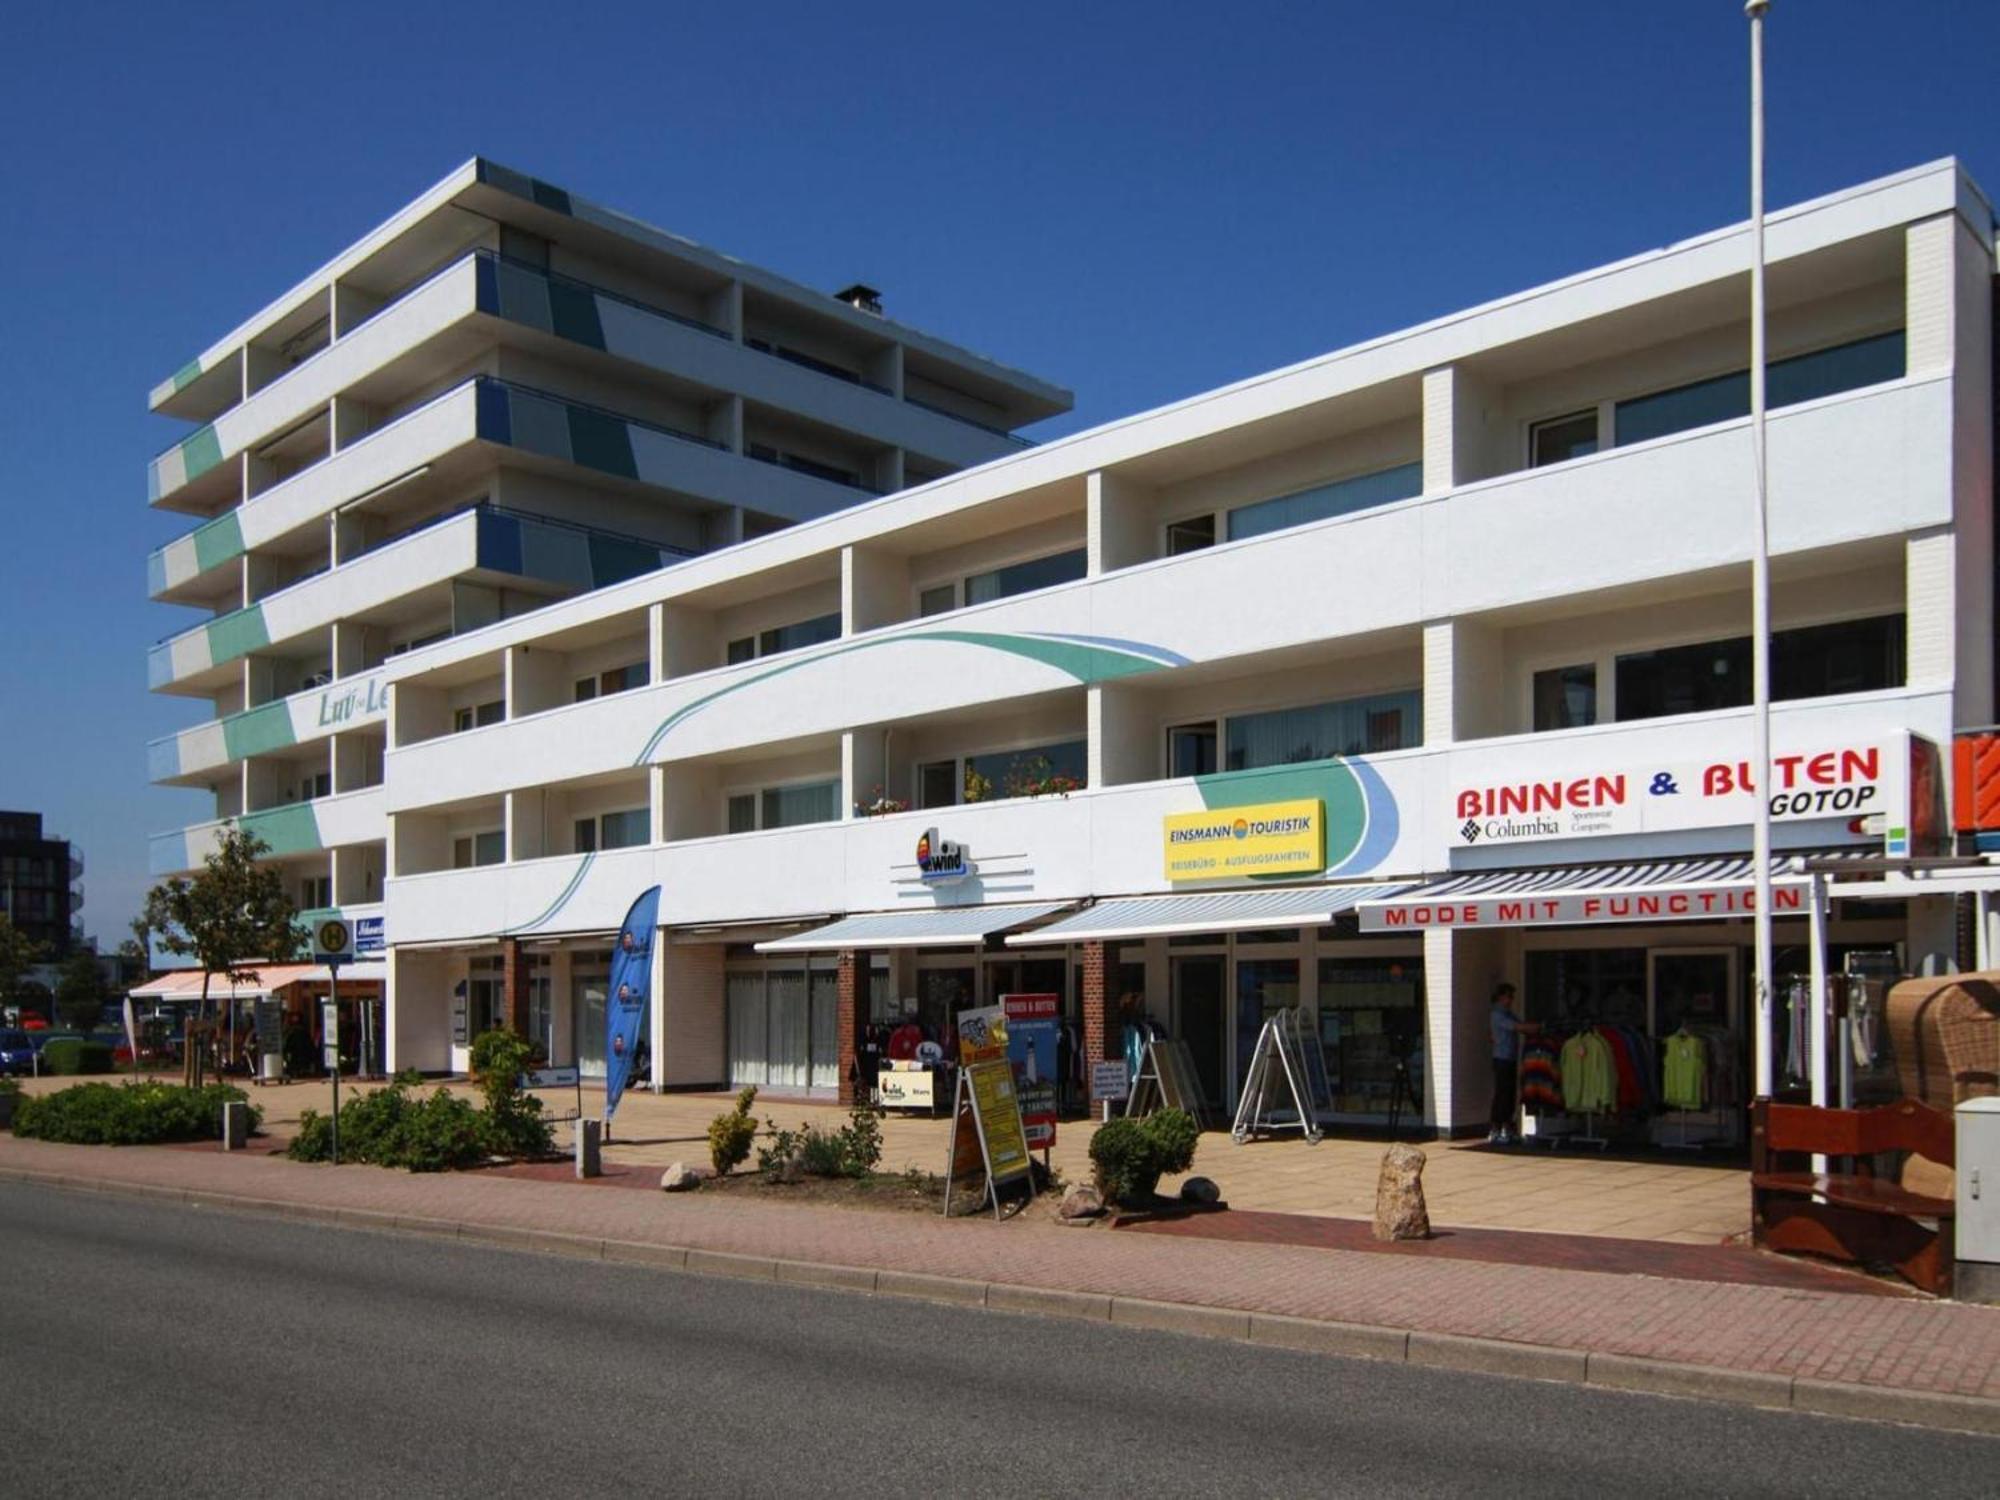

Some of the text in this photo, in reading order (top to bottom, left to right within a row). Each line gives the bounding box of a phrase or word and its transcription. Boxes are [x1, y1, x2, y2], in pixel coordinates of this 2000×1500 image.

[1457, 774, 1625, 819] BINNEN
[1648, 771, 1679, 796] &
[1770, 786, 1876, 816] GOTOP
[1170, 817, 1311, 842] EINSMANN TOURISTIK
[1485, 816, 1559, 839] Columbia
[931, 843, 961, 872] wind
[1171, 856, 1216, 871] REISEBÜRO
[1225, 851, 1311, 866] AUSFLUGSFAHRTEN
[1385, 905, 1479, 925] MODE
[1498, 901, 1560, 921] MIT
[327, 928, 341, 945] H
